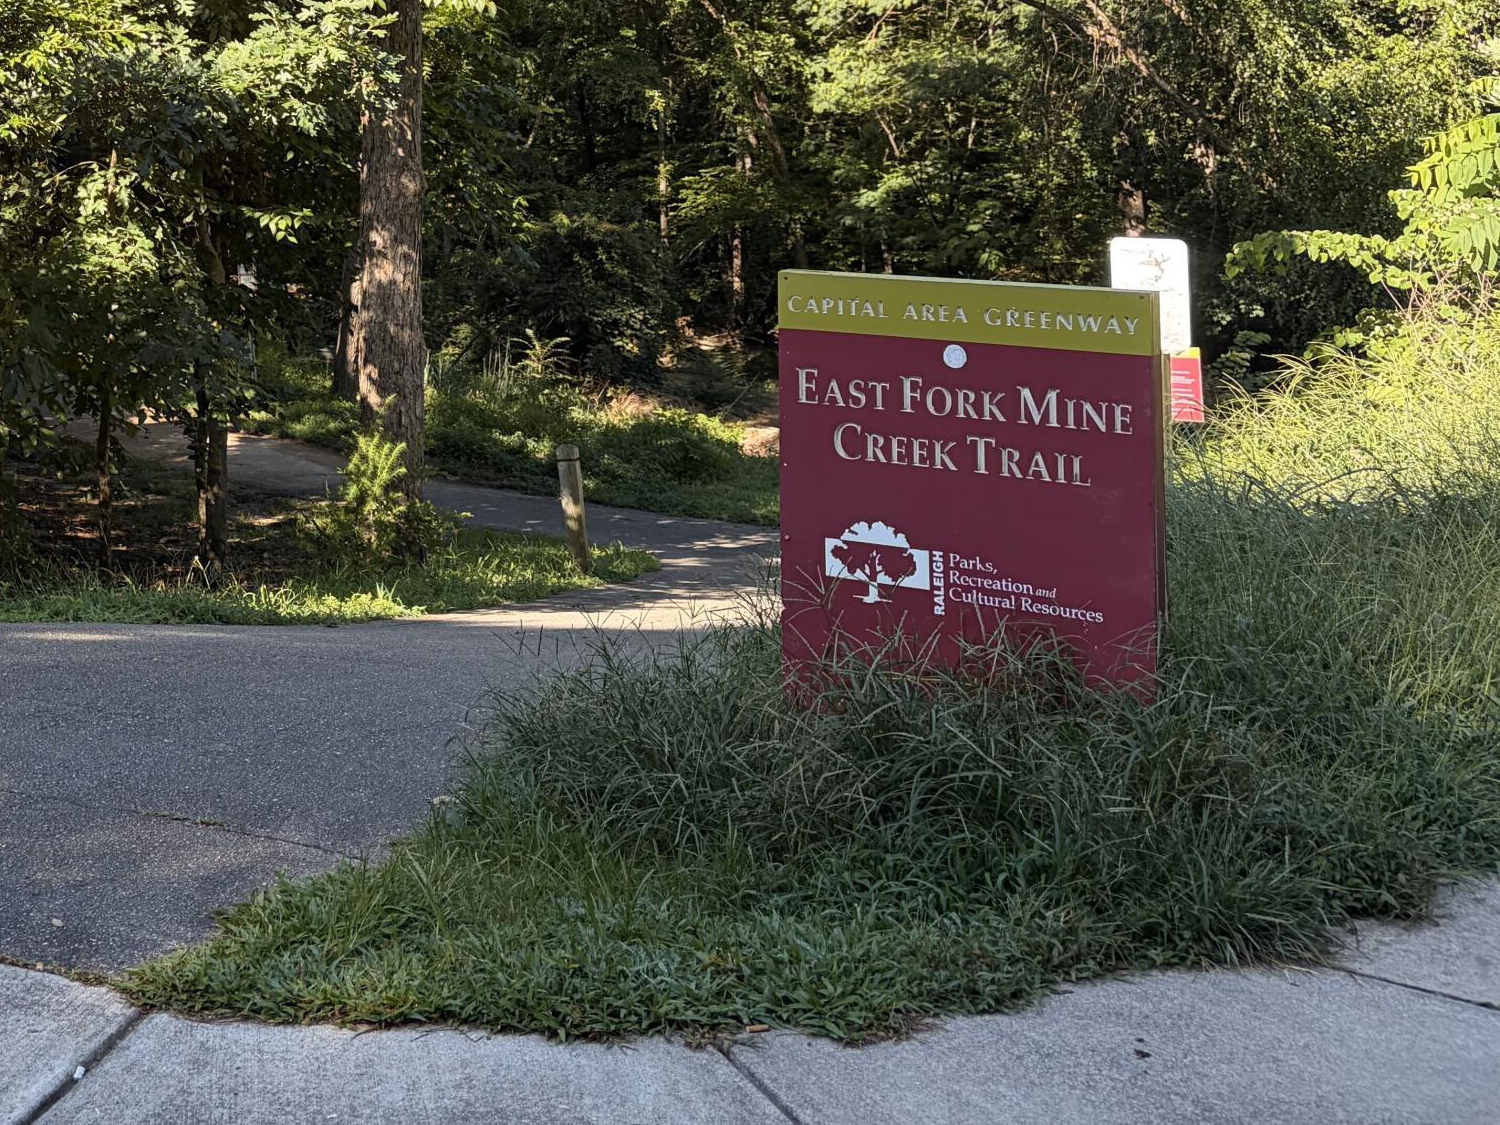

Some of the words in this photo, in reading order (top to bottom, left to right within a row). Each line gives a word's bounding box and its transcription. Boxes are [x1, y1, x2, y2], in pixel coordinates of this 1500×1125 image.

[787, 295, 889, 319] CAPITAL
[902, 302, 968, 324] AREA
[983, 307, 1140, 336] GREENWAY
[795, 367, 890, 412] EAST
[900, 375, 1007, 422] FORK
[1015, 385, 1133, 435] MINE
[833, 422, 957, 472] CREEK
[966, 436, 1092, 487] TRAIL
[932, 550, 946, 616] RALEIGH
[949, 553, 998, 575] Parks,
[949, 570, 1033, 595] Recreation
[1035, 587, 1057, 599] and
[949, 587, 1015, 610] Cultural
[1020, 596, 1104, 623] Resources
